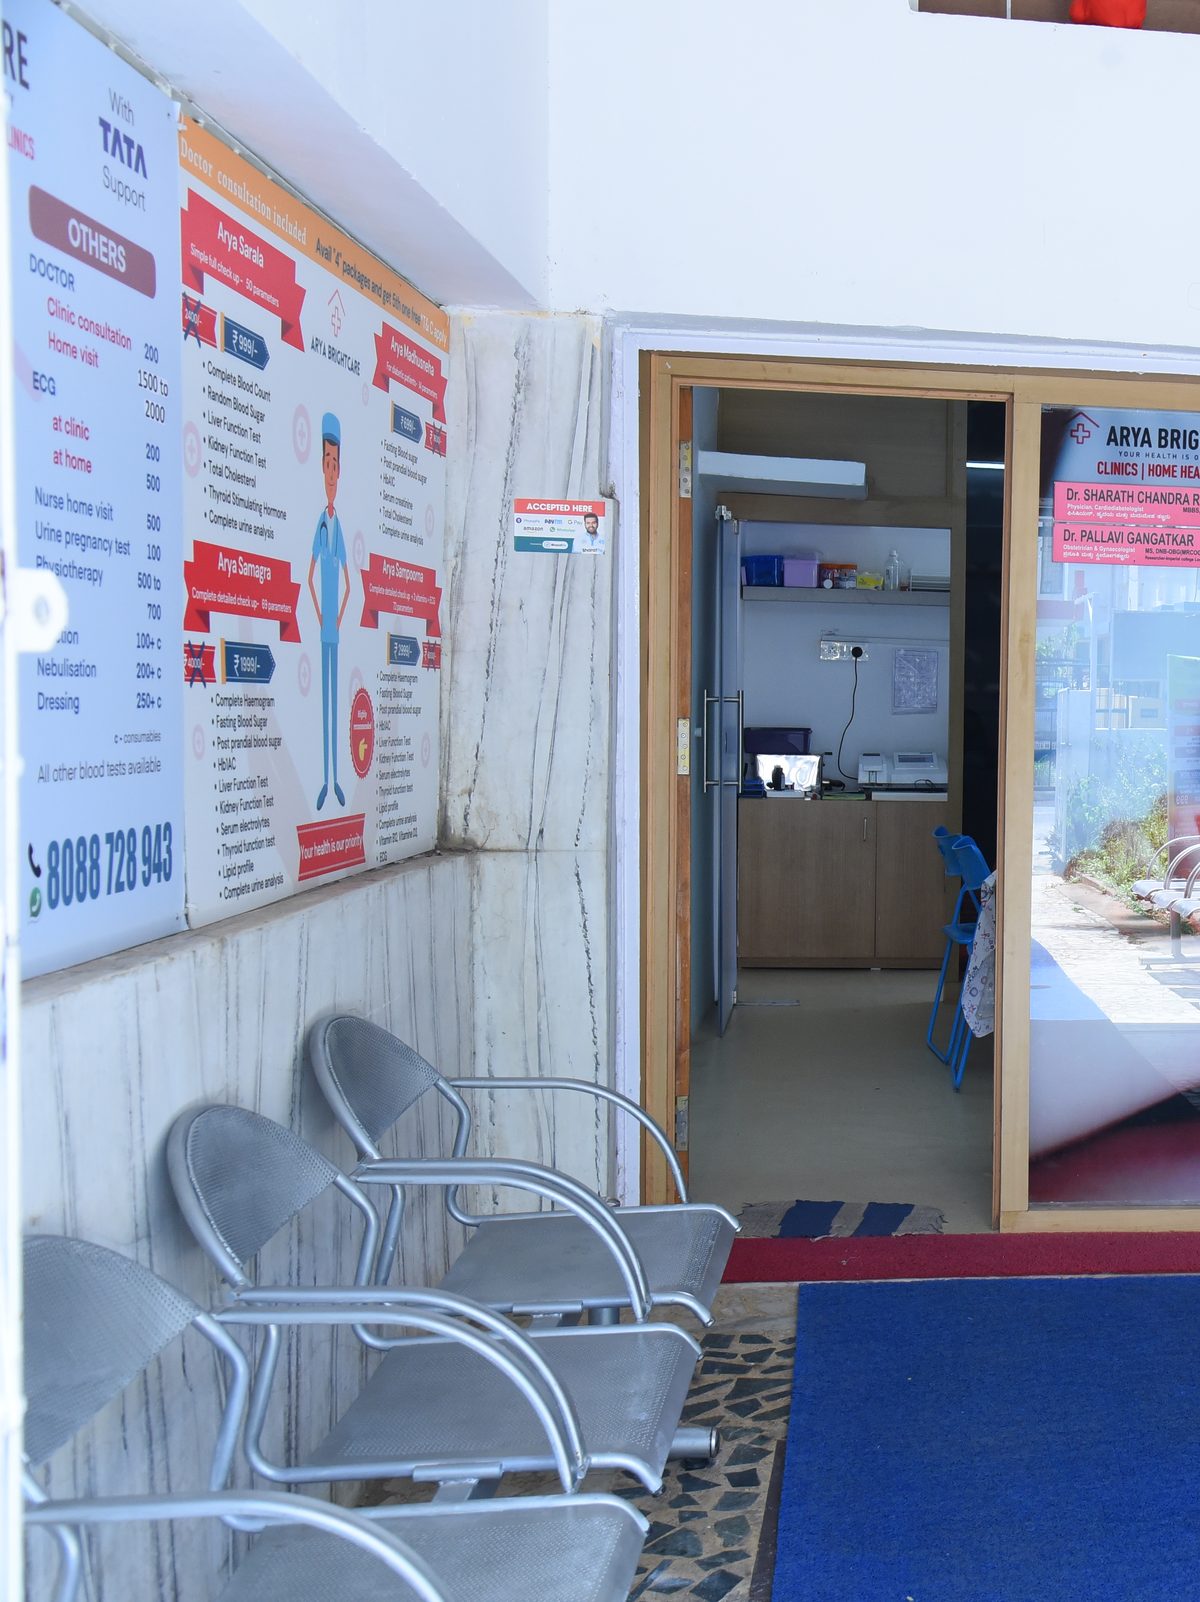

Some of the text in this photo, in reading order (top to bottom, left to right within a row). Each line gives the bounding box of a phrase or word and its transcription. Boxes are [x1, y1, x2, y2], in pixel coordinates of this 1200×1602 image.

[108, 88, 135, 126] With
[99, 116, 147, 179] TATA
[102, 165, 146, 212] Support
[181, 137, 307, 245] Doctor consultation included
[68, 218, 126, 273] OTHERS
[217, 222, 264, 268] Arya Sarala
[30, 254, 75, 292] DOCTOR
[47, 297, 159, 363] Clinic consultation 200
[239, 335, 258, 358] 999/-
[311, 336, 360, 376] ARYA BRIGHTCARE
[48, 331, 158, 392] Home visit 1500
[32, 370, 56, 396] ECG
[208, 386, 232, 406] Random
[238, 375, 253, 394] Blood
[145, 400, 165, 423] 2000
[53, 415, 160, 462] at clinic 200
[208, 410, 261, 444] Liver Function Test
[1106, 425, 1152, 448] ARYA
[208, 435, 266, 469] Kidney Test
[1145, 452, 1178, 460] HEALTH
[53, 449, 160, 492] at home 500
[208, 460, 256, 488] Total Cholesterol
[1097, 461, 1138, 476] CLINICS
[1148, 464, 1177, 478] HOME
[35, 486, 161, 532] Nurse home visit 500
[527, 503, 592, 513] ACCEPTED HERE
[1066, 488, 1080, 501] Dr.
[1083, 489, 1134, 504] SHARATH
[1137, 491, 1190, 506] CHANDRA
[1192, 494, 1200, 506] R
[35, 520, 161, 562] Urine pregnancy test 100
[1063, 529, 1077, 542] Dr.
[1080, 530, 1124, 544] PALLAVI
[1127, 532, 1194, 546] GANGATKAR
[1063, 544, 1093, 552] Obstetrician
[1099, 546, 1136, 554] Gynaecologist
[36, 555, 152, 590] Physiotherapy 500
[218, 552, 271, 584] Arya Samagra
[147, 603, 161, 620] 700
[37, 658, 96, 678] Nebulisation
[240, 656, 260, 674] 1999/-
[38, 692, 80, 714] Dressing
[244, 694, 275, 713] Haemogram
[38, 757, 161, 783] All other blood tests available
[239, 817, 270, 834] electrolytes
[301, 834, 363, 860] Your health is our priority
[47, 821, 173, 910] 8088 728 943
